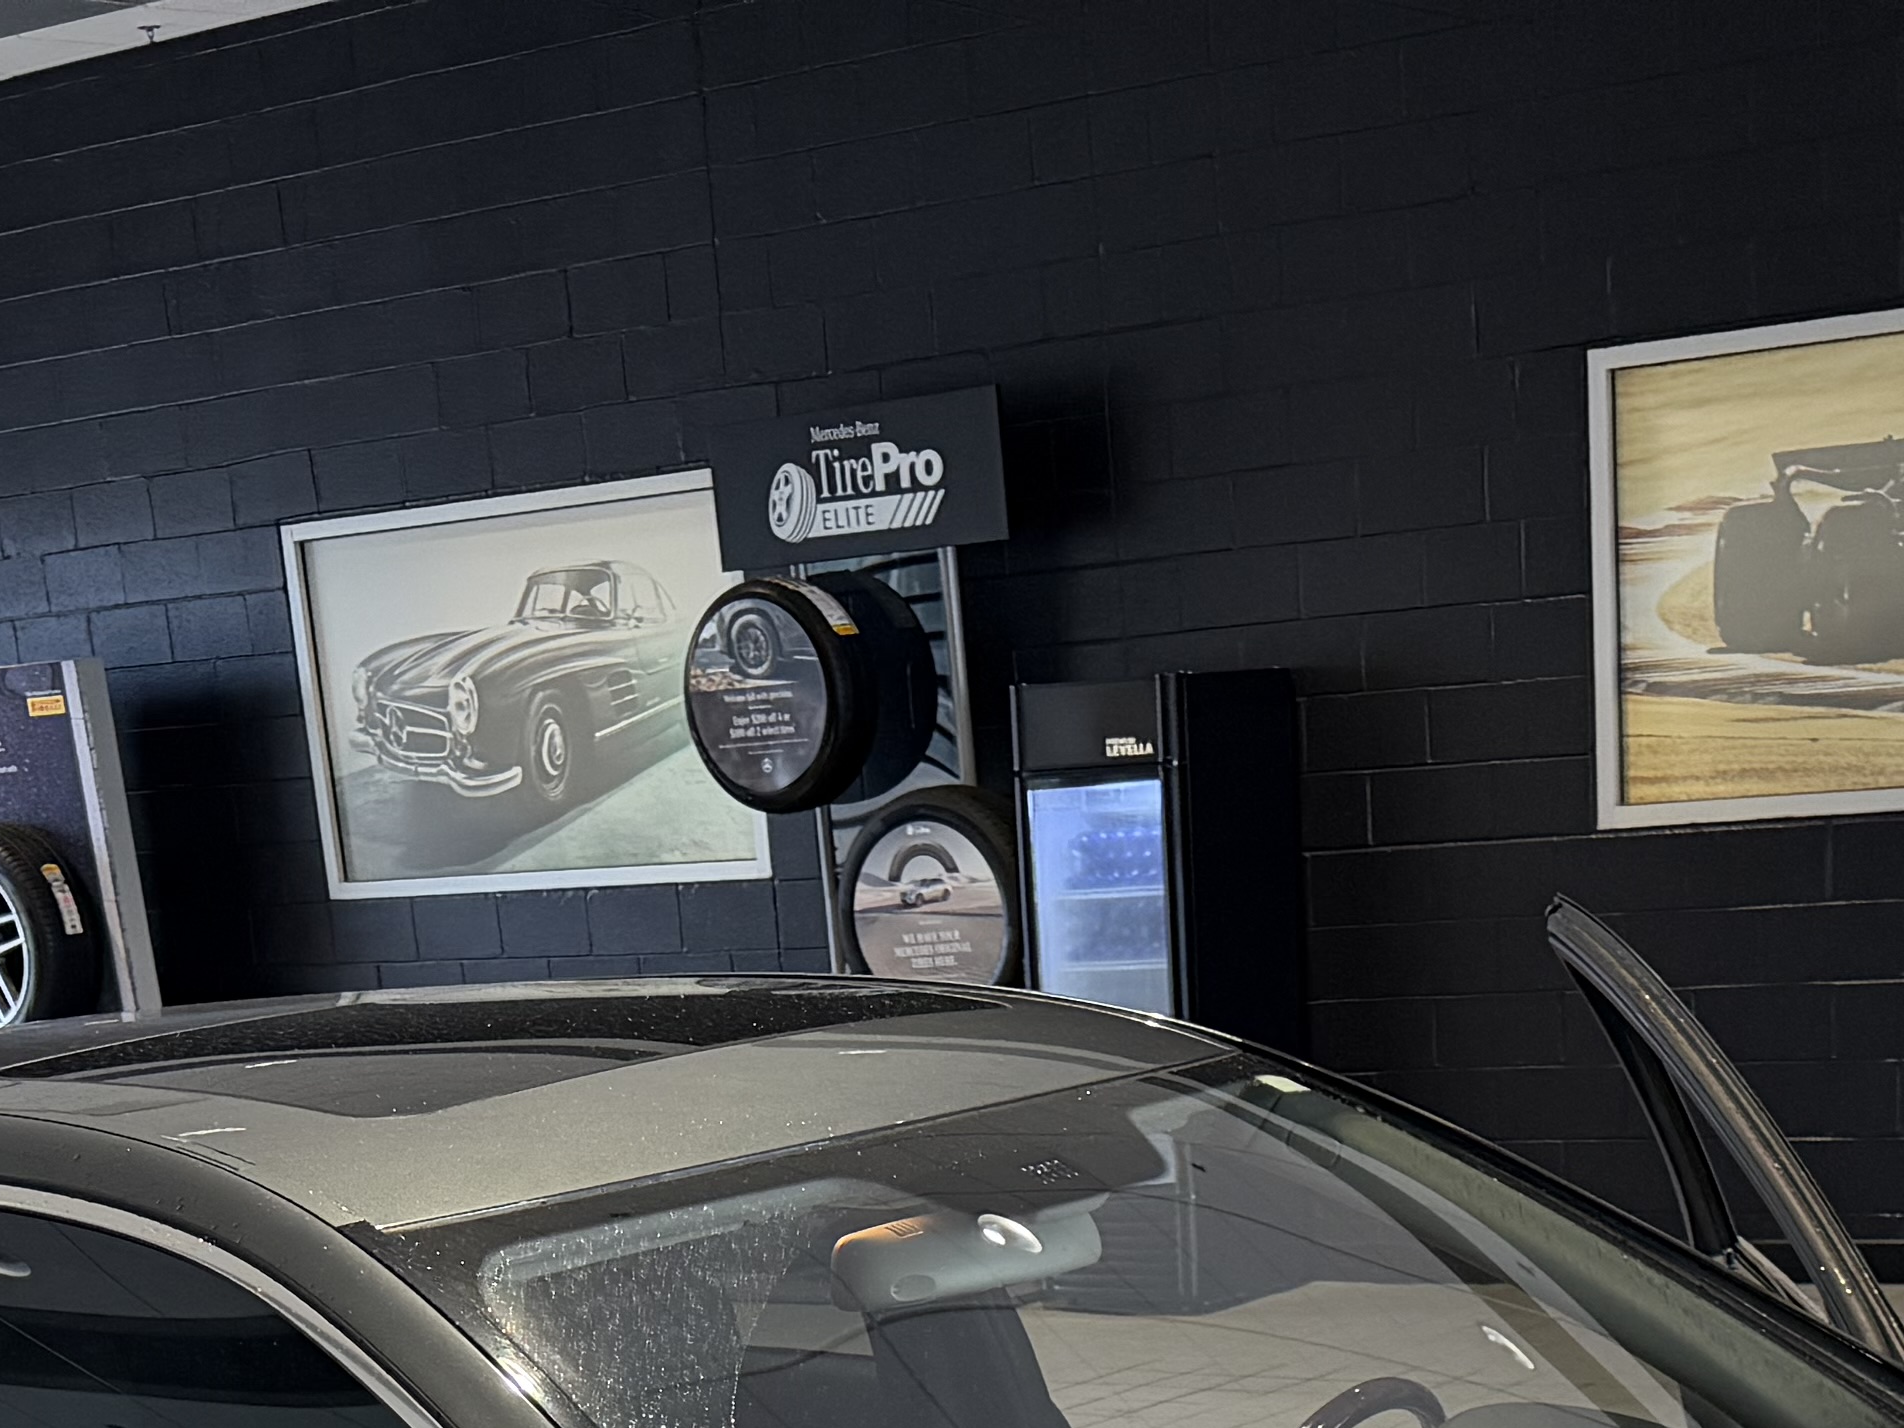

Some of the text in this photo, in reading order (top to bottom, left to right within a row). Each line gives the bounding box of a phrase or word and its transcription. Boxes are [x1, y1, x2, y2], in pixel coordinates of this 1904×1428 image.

[809, 421, 880, 443] Mercedes-Benz
[811, 441, 944, 499] TirePro
[822, 504, 876, 531] ELITE
